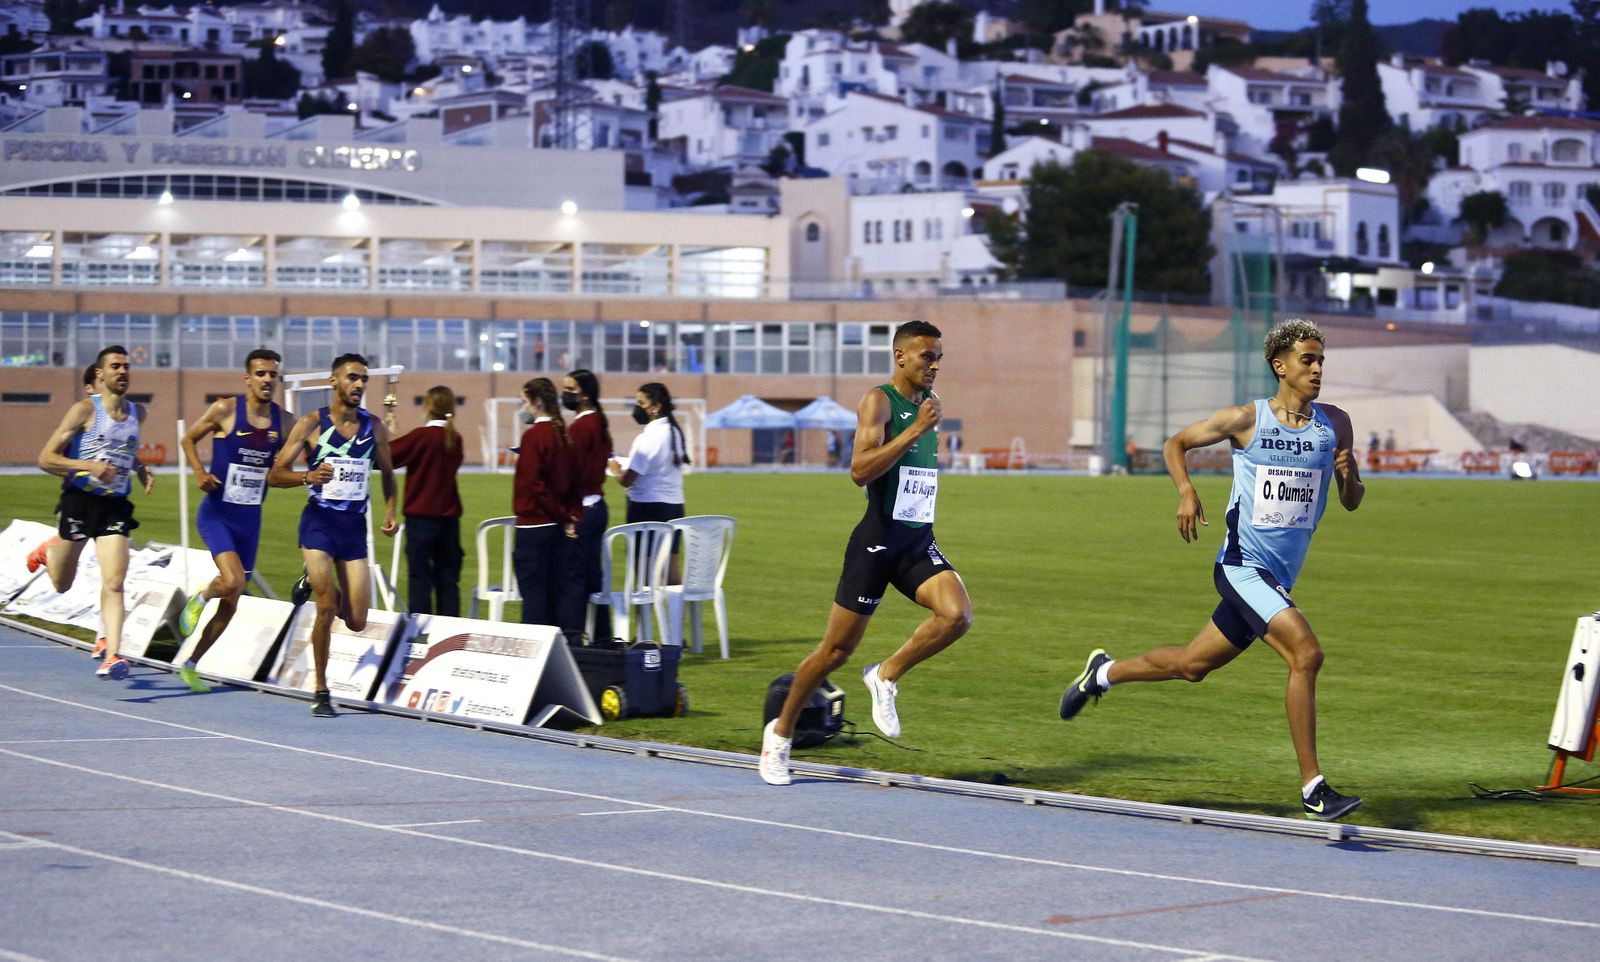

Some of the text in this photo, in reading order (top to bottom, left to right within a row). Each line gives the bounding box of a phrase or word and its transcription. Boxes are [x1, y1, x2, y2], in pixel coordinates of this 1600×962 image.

[3, 139, 108, 163] PISCINA
[120, 141, 140, 164] Y
[1261, 437, 1314, 455] nerja
[1269, 454, 1308, 463] ATLETISMO
[1268, 468, 1292, 477] DESAFÍO
[903, 479, 911, 494] A.
[1263, 480, 1314, 502] O. Oumaiz
[1304, 503, 1309, 513] 1
